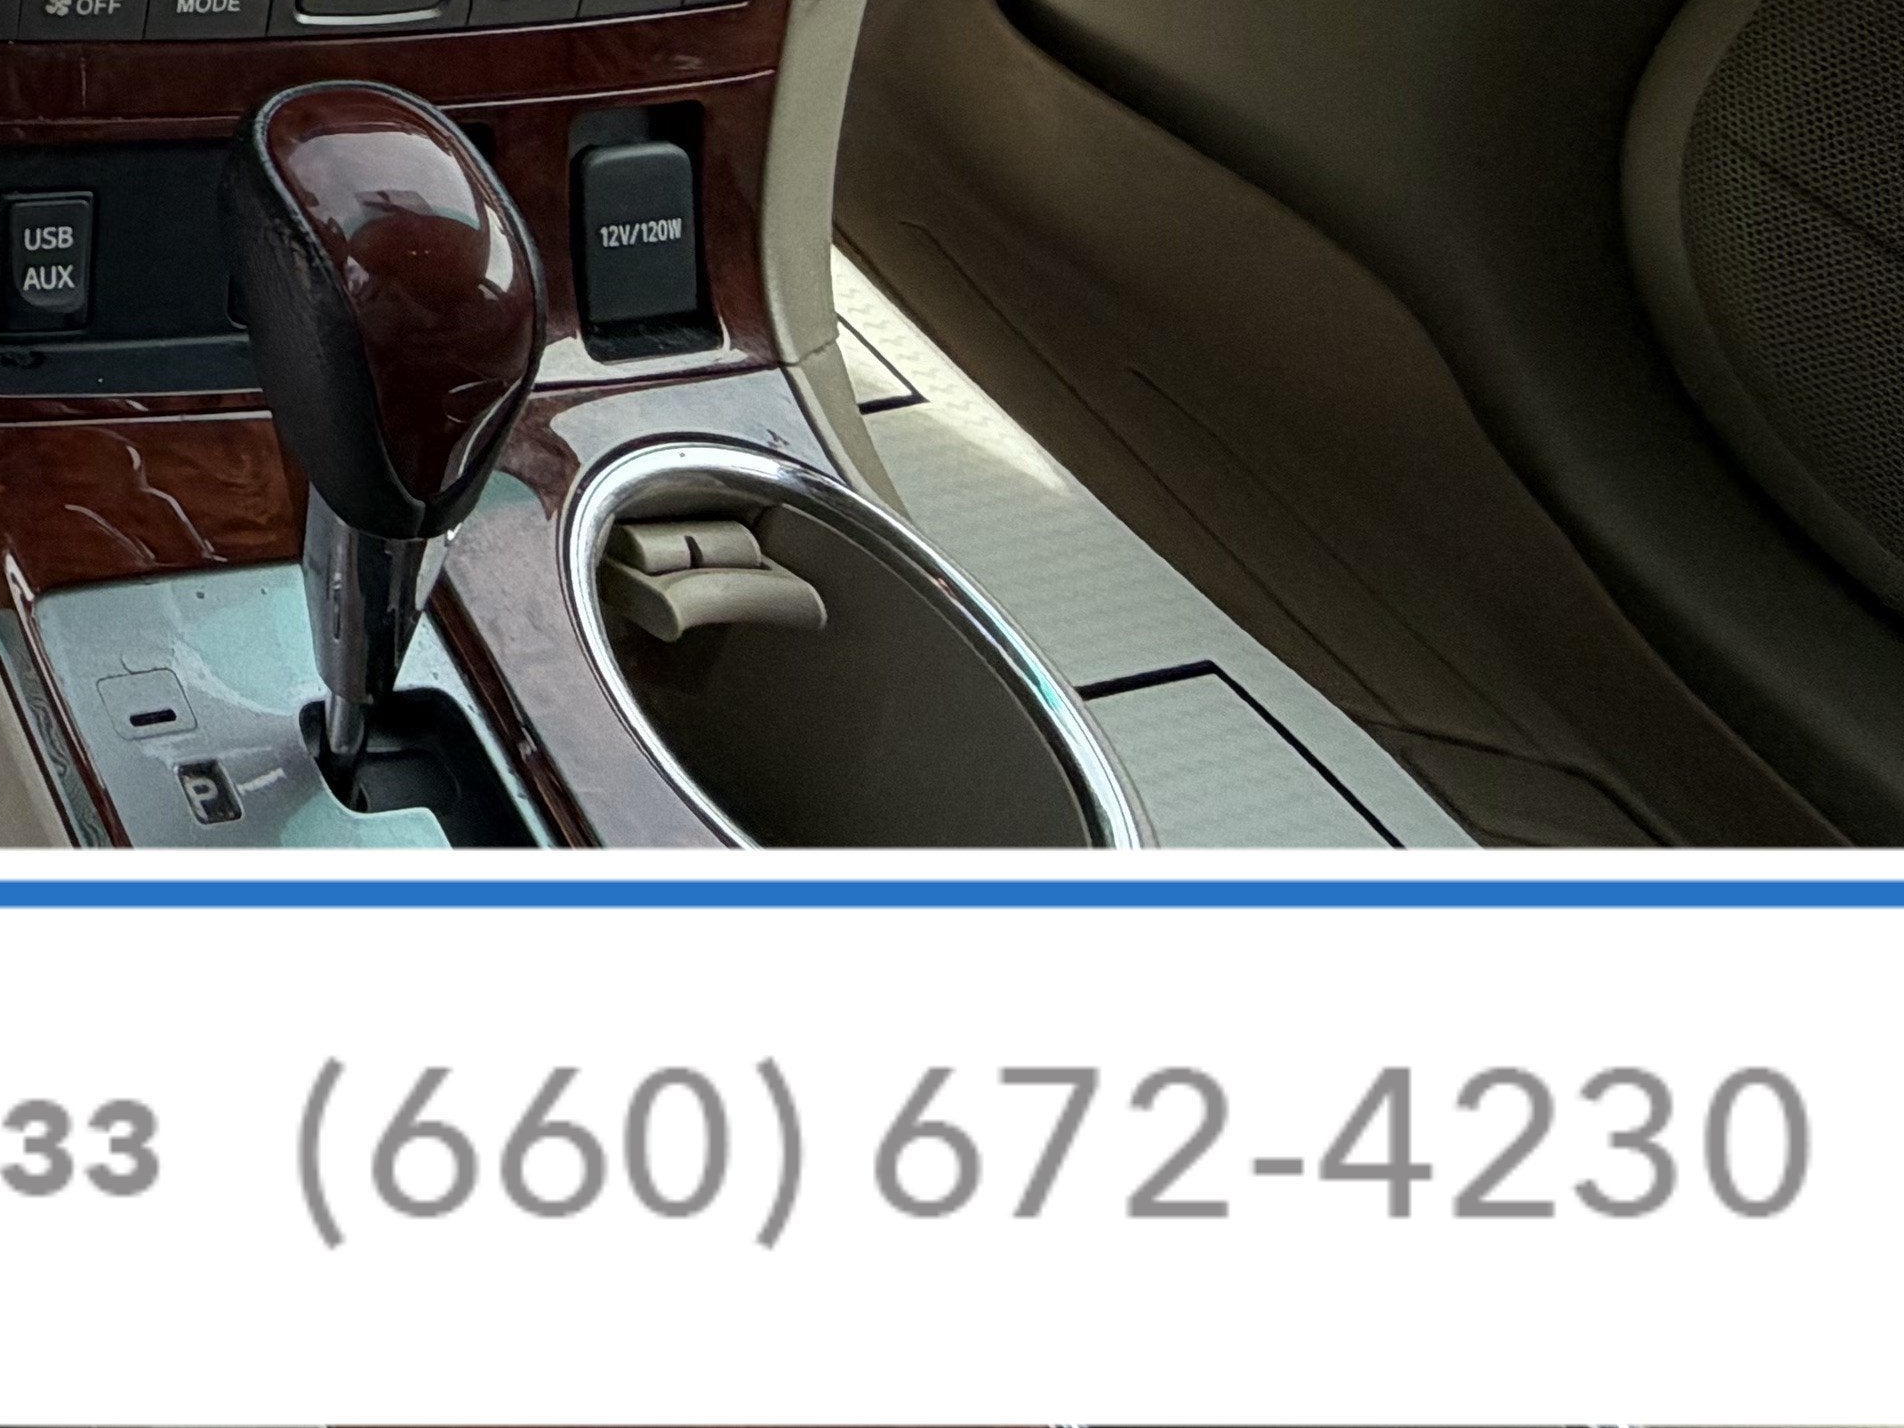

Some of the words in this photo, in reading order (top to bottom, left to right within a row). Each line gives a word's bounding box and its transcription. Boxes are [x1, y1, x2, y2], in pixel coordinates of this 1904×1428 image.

[23, 225, 74, 252] USB
[599, 217, 682, 247] 12V/120W
[22, 263, 76, 291] AUX
[185, 774, 218, 817] P
